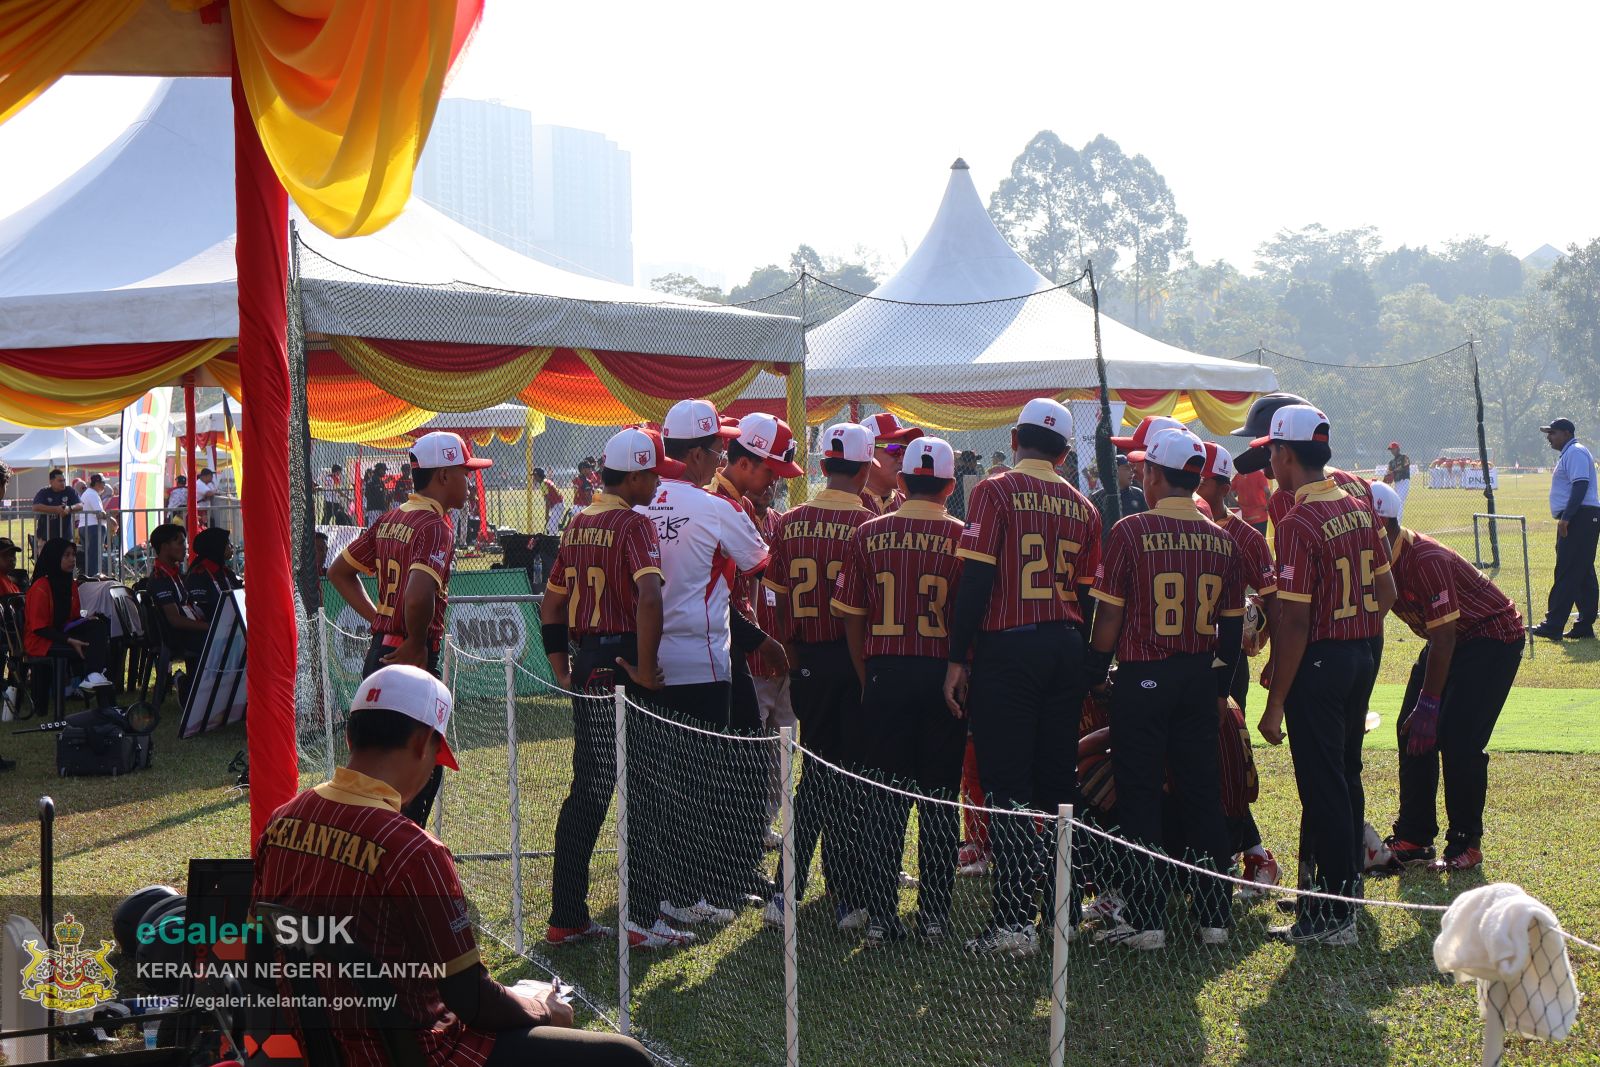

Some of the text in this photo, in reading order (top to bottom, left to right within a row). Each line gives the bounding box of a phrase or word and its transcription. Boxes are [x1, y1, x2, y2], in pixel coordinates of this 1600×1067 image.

[1044, 415, 1056, 427] 25
[1468, 476, 1494, 484] PNB
[1012, 491, 1090, 523] KELANTAN
[783, 520, 857, 541] KELANTA
[1141, 532, 1232, 557] KELANTAN
[1021, 533, 1082, 602] 25
[564, 566, 606, 628] 77
[872, 571, 949, 638] 13
[1153, 572, 1222, 636] 88
